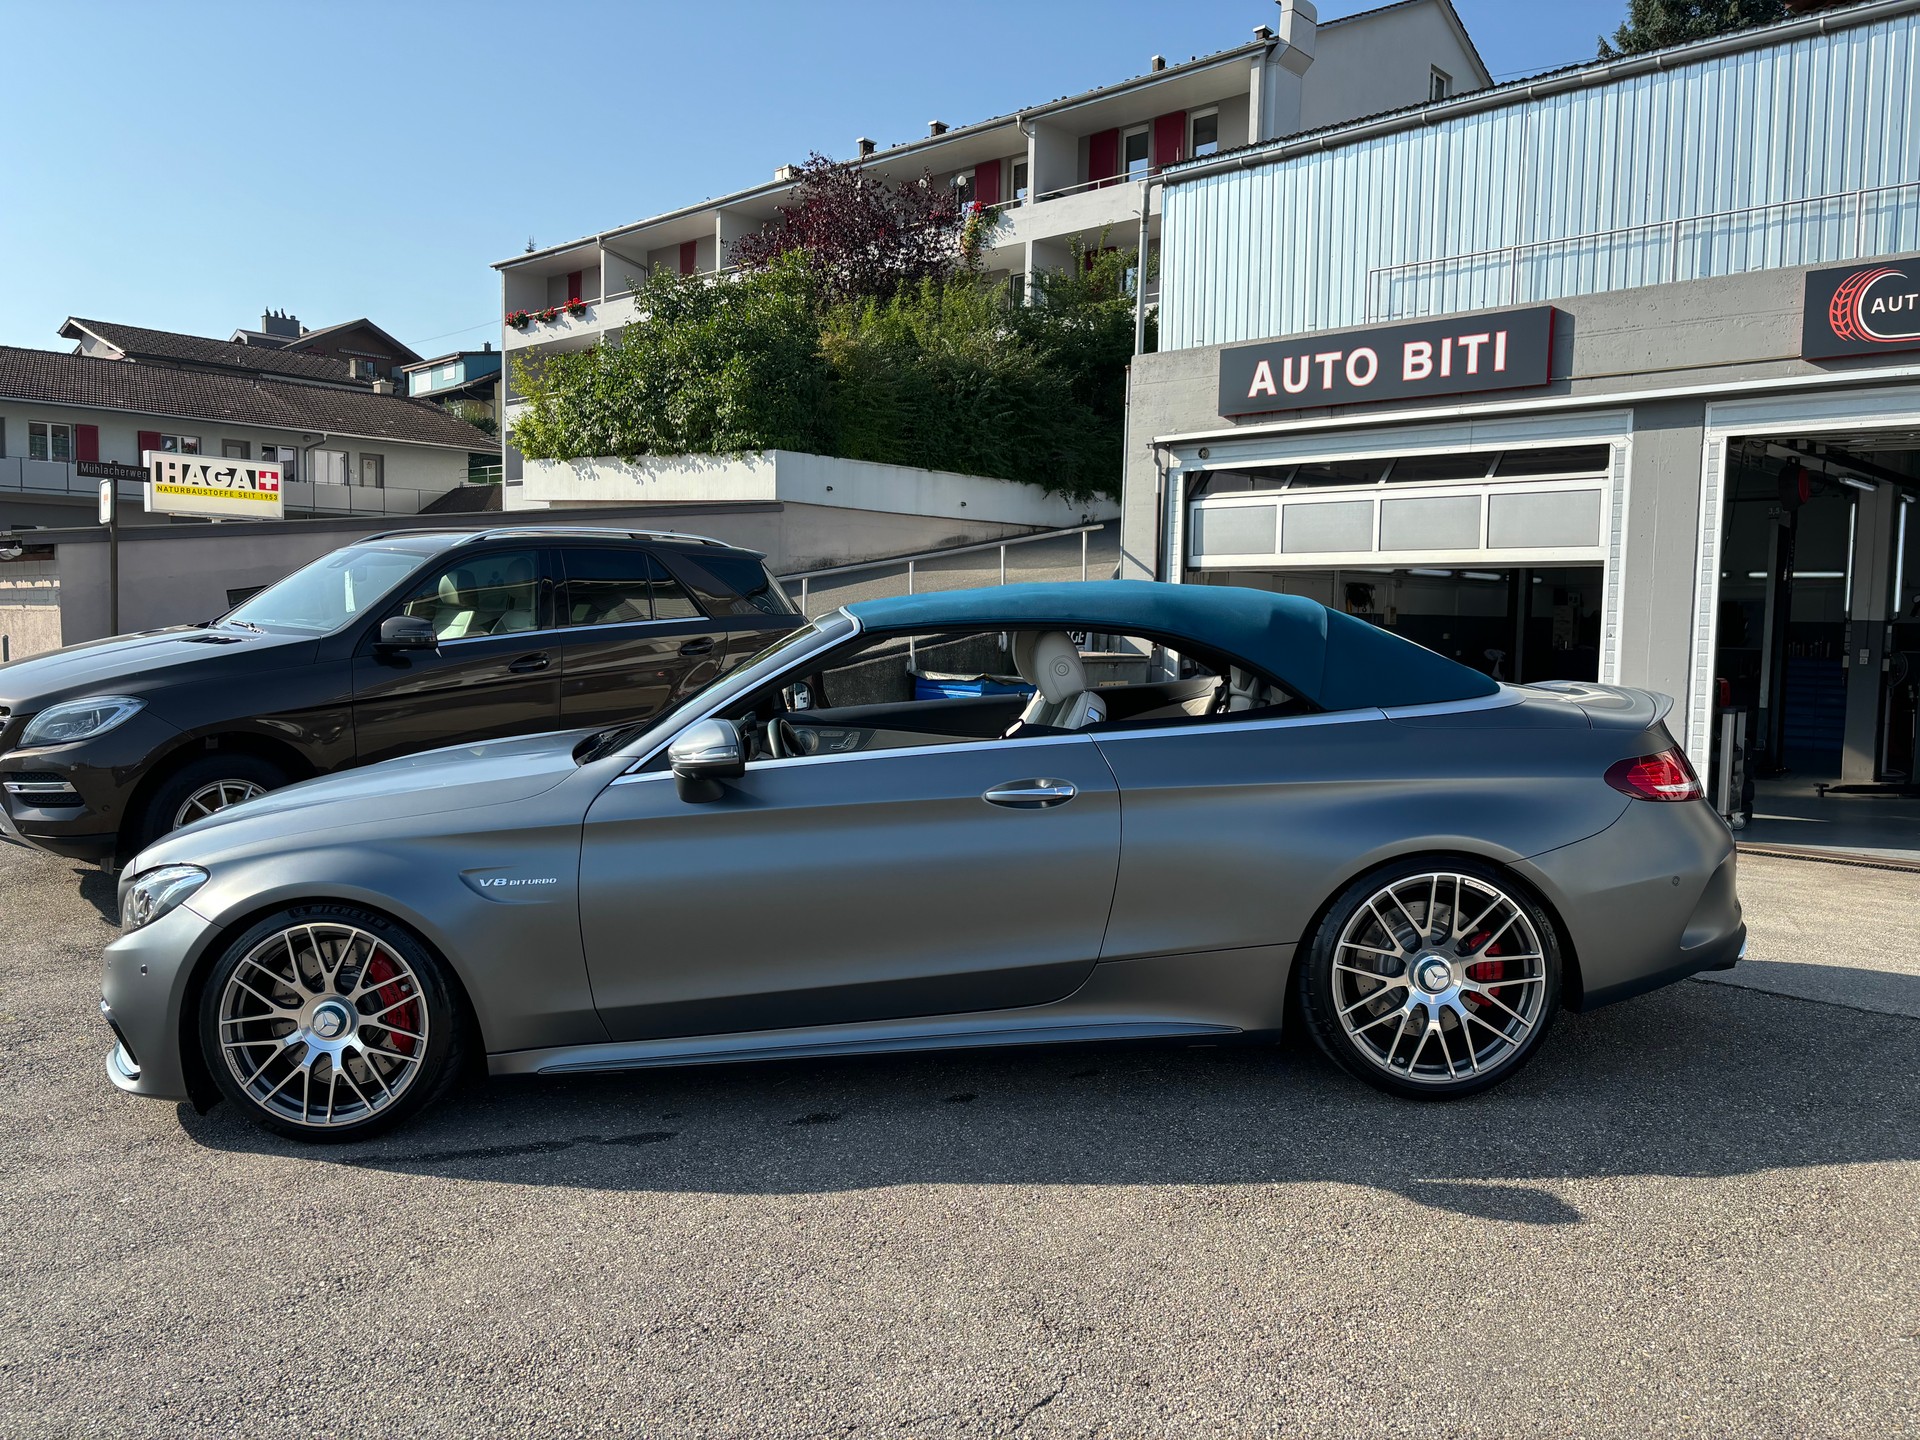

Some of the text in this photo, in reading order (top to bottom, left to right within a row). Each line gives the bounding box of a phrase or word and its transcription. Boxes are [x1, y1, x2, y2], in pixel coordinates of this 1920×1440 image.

[1870, 293, 1919, 314] AUT
[1247, 330, 1507, 398] AUTO BITI
[80, 463, 148, 481] Mühlacherweg
[160, 459, 252, 489] HAGA
[156, 485, 279, 501] NATURBAUSTOFFE SEIT 1953
[479, 878, 508, 887] V8
[309, 905, 388, 929] MICHELIN
